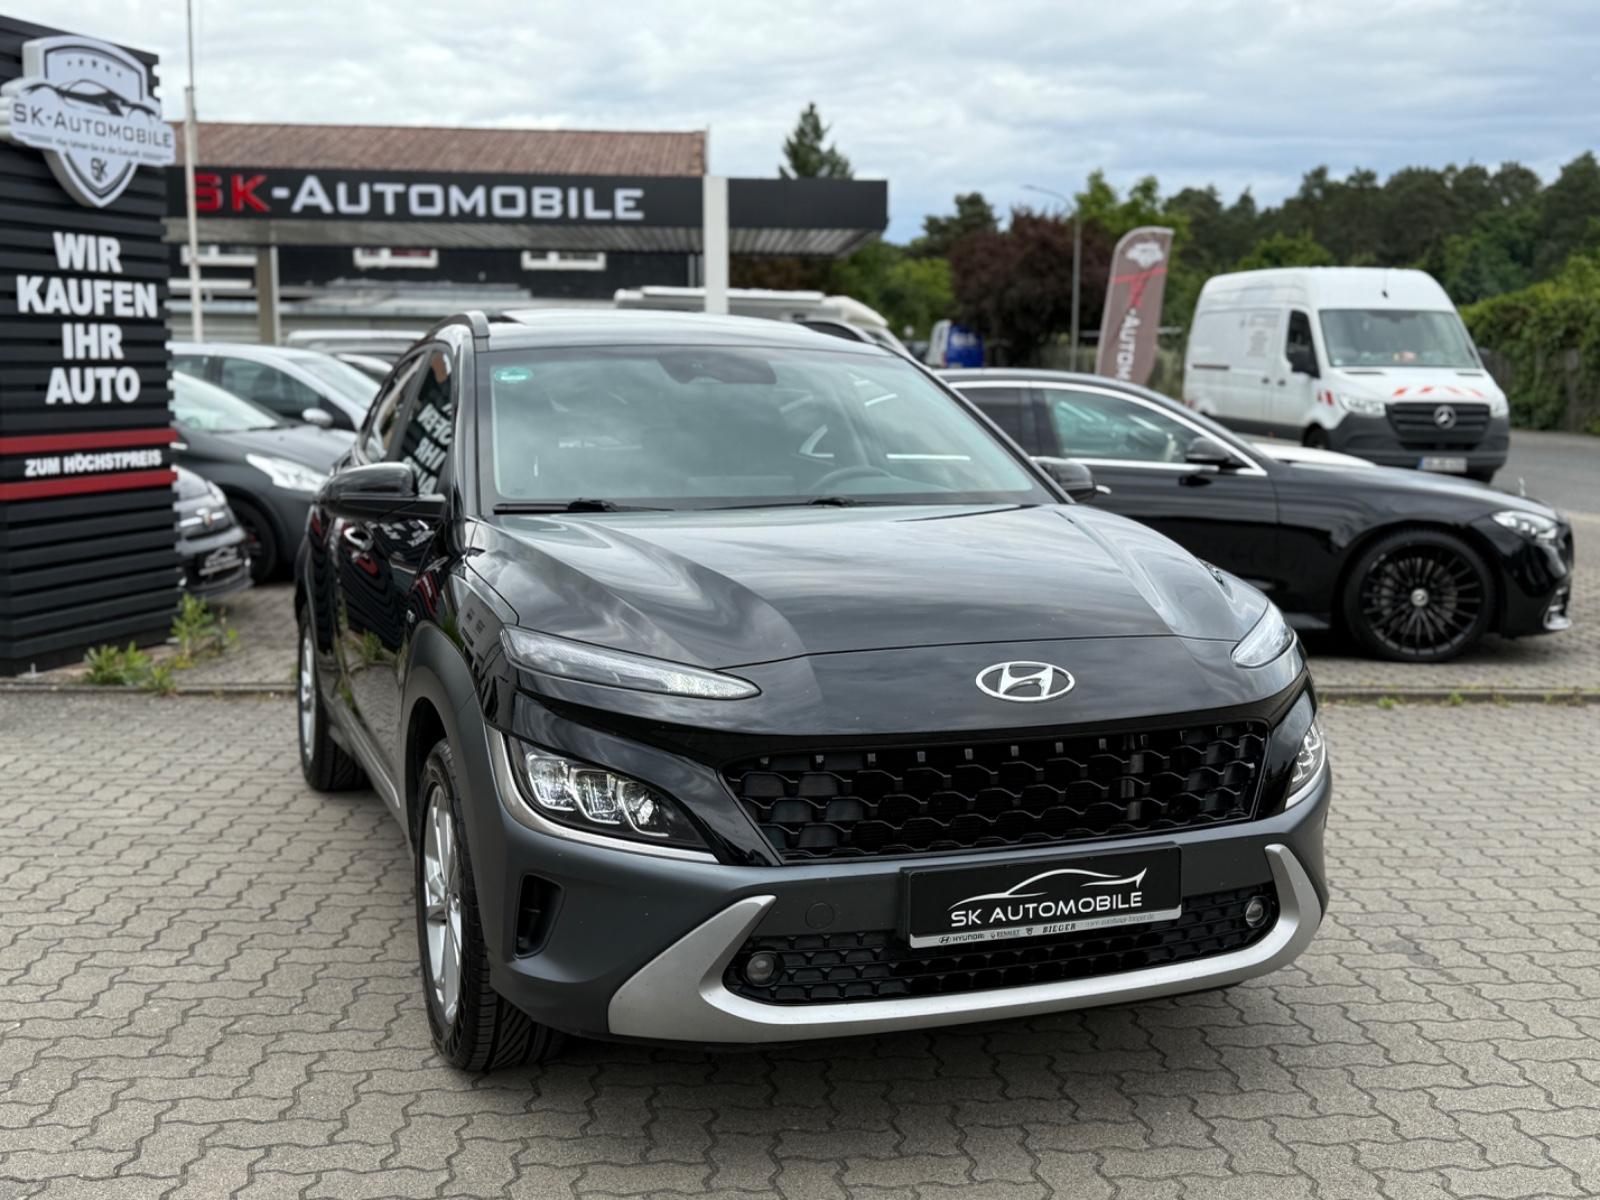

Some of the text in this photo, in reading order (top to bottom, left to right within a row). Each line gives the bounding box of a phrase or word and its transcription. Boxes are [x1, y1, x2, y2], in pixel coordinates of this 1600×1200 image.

[53, 231, 123, 273] WIR
[16, 275, 158, 318] KAUFEN
[61, 323, 124, 360] IHR
[45, 366, 141, 404] AUTO
[25, 449, 162, 477] ZUM HÖCHSTPREIS
[950, 891, 1143, 928] SK AUTOMOBILE
